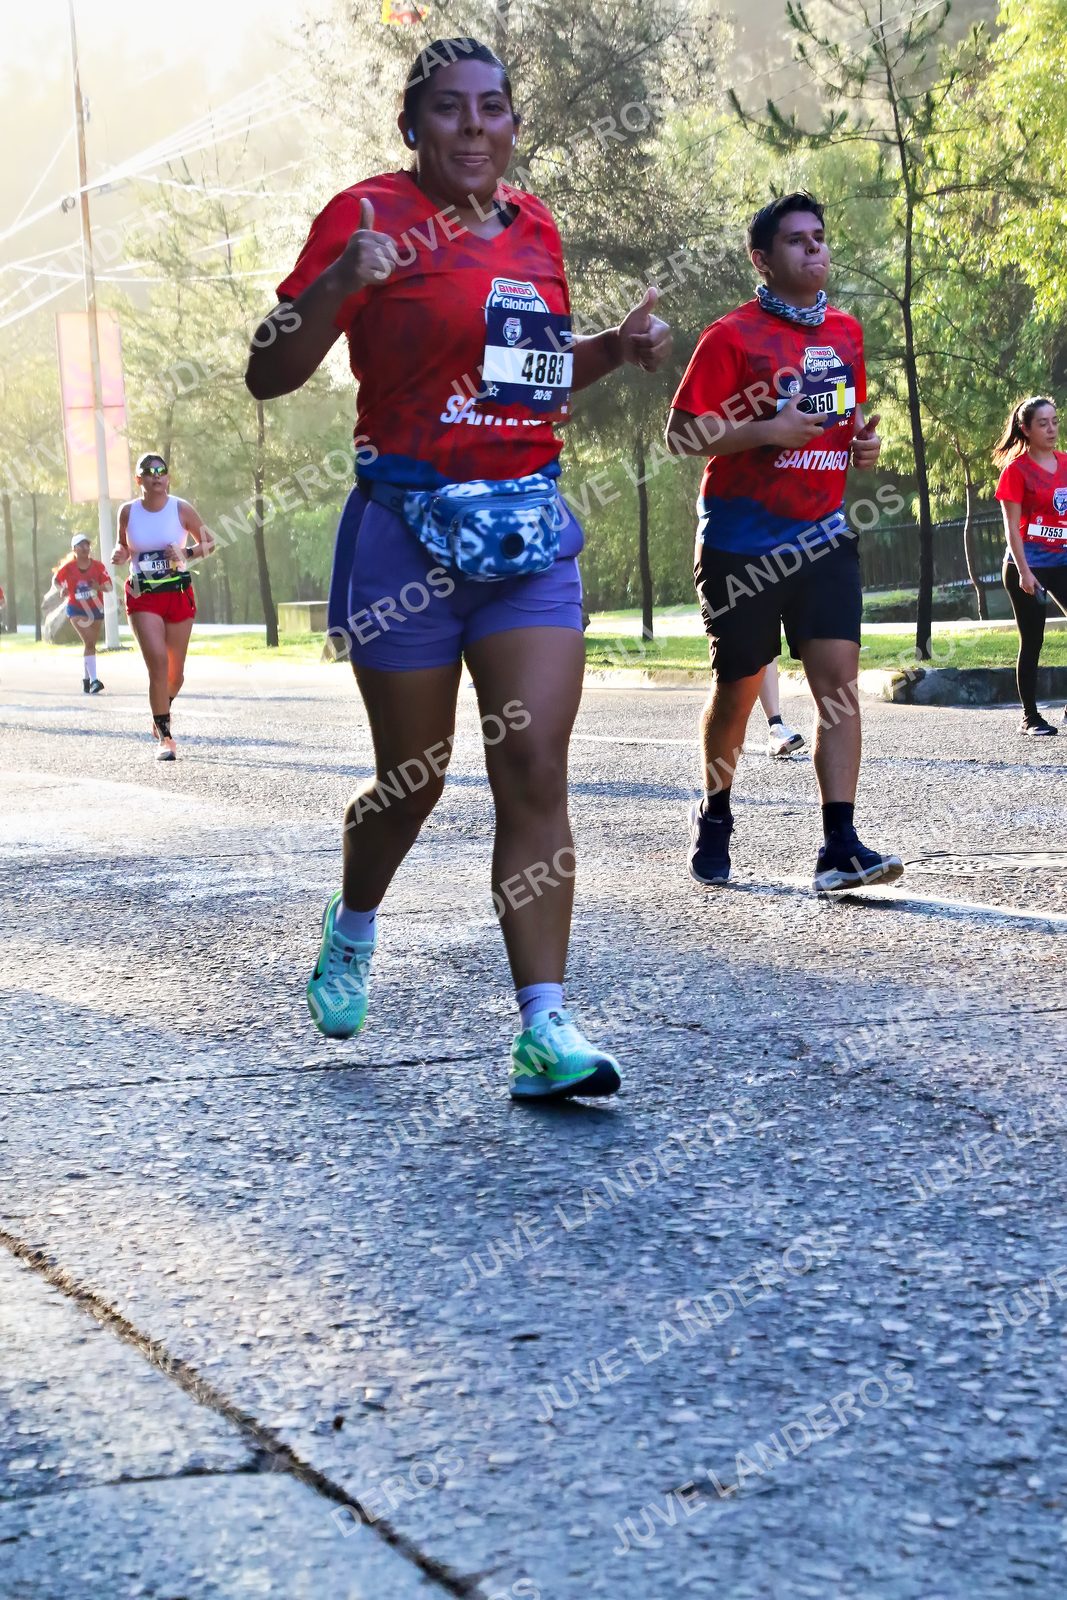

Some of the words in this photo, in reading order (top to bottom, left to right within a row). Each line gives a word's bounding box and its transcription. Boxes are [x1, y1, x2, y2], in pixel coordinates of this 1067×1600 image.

[499, 284, 533, 296] BIMBO
[502, 297, 536, 311] Global
[521, 352, 564, 385] 4883
[813, 358, 835, 368] Global
[774, 450, 849, 471] SANTIAGO
[1040, 526, 1064, 538] 17553
